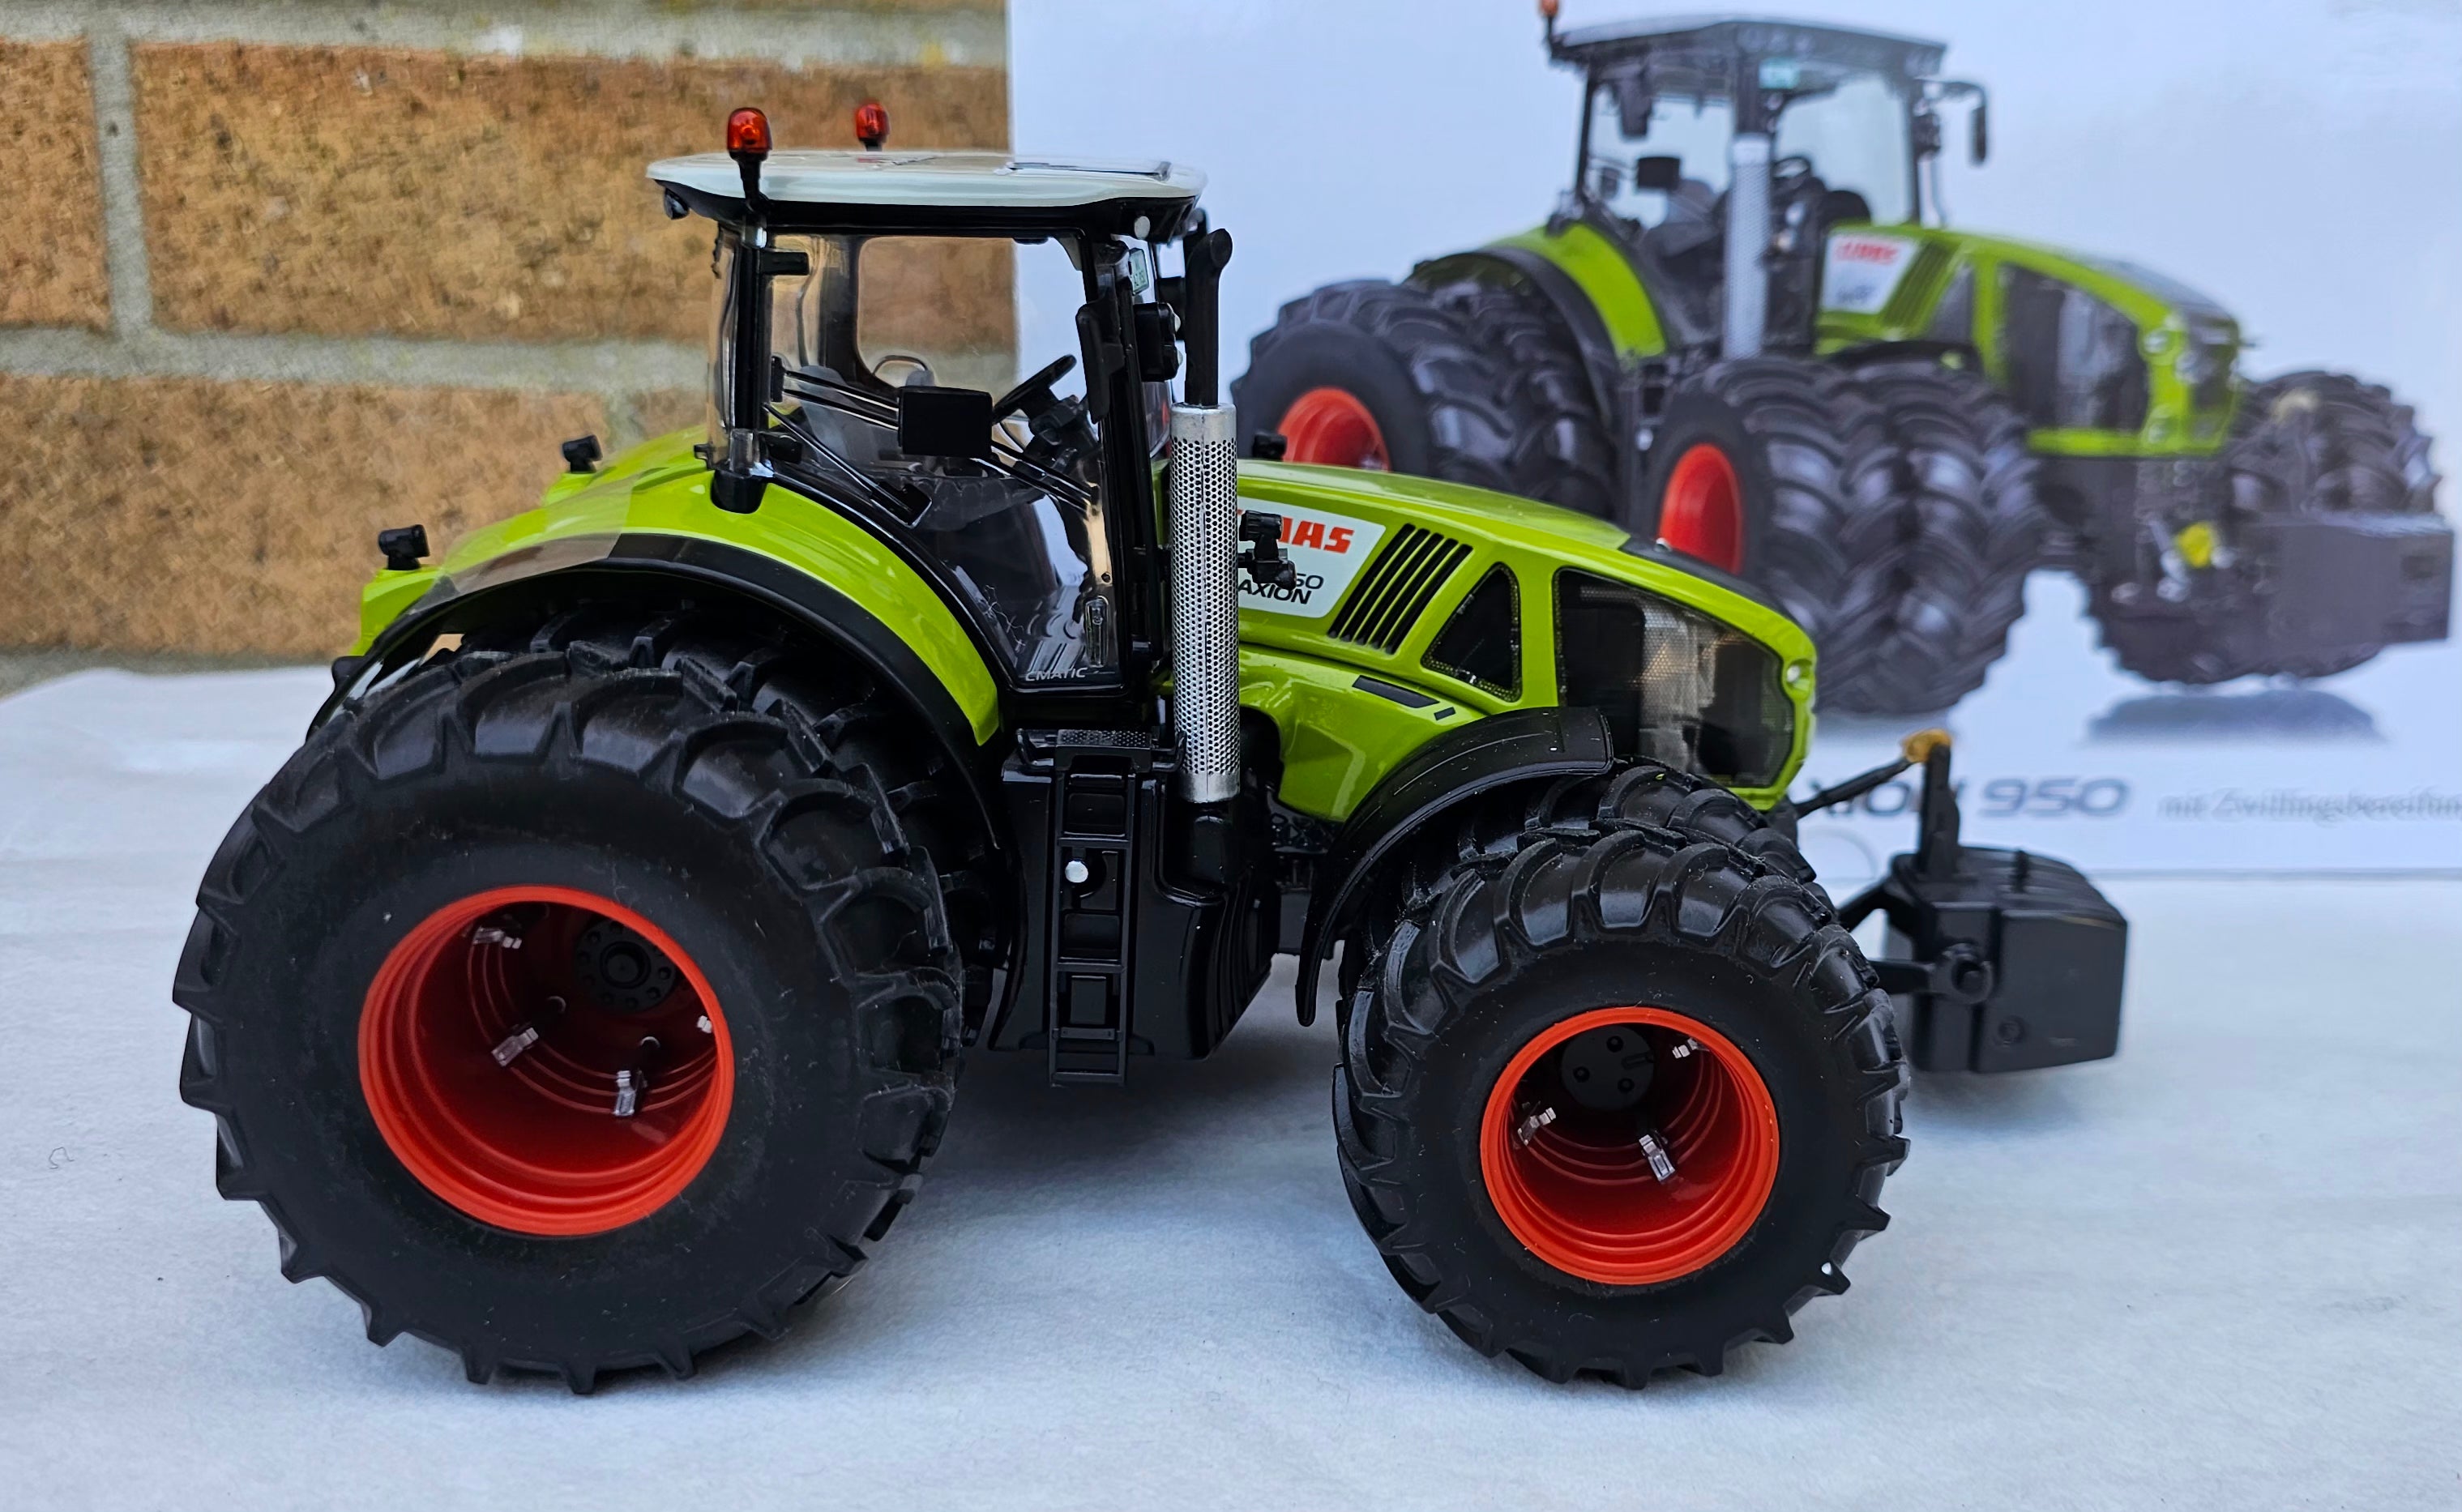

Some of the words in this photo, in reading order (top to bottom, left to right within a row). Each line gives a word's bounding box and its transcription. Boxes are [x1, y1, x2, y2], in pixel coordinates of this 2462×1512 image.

[1237, 579, 1312, 604] AXION
[1296, 572, 1324, 590] 50
[1025, 667, 1088, 681] CMATIC
[1979, 775, 2131, 818] 950
